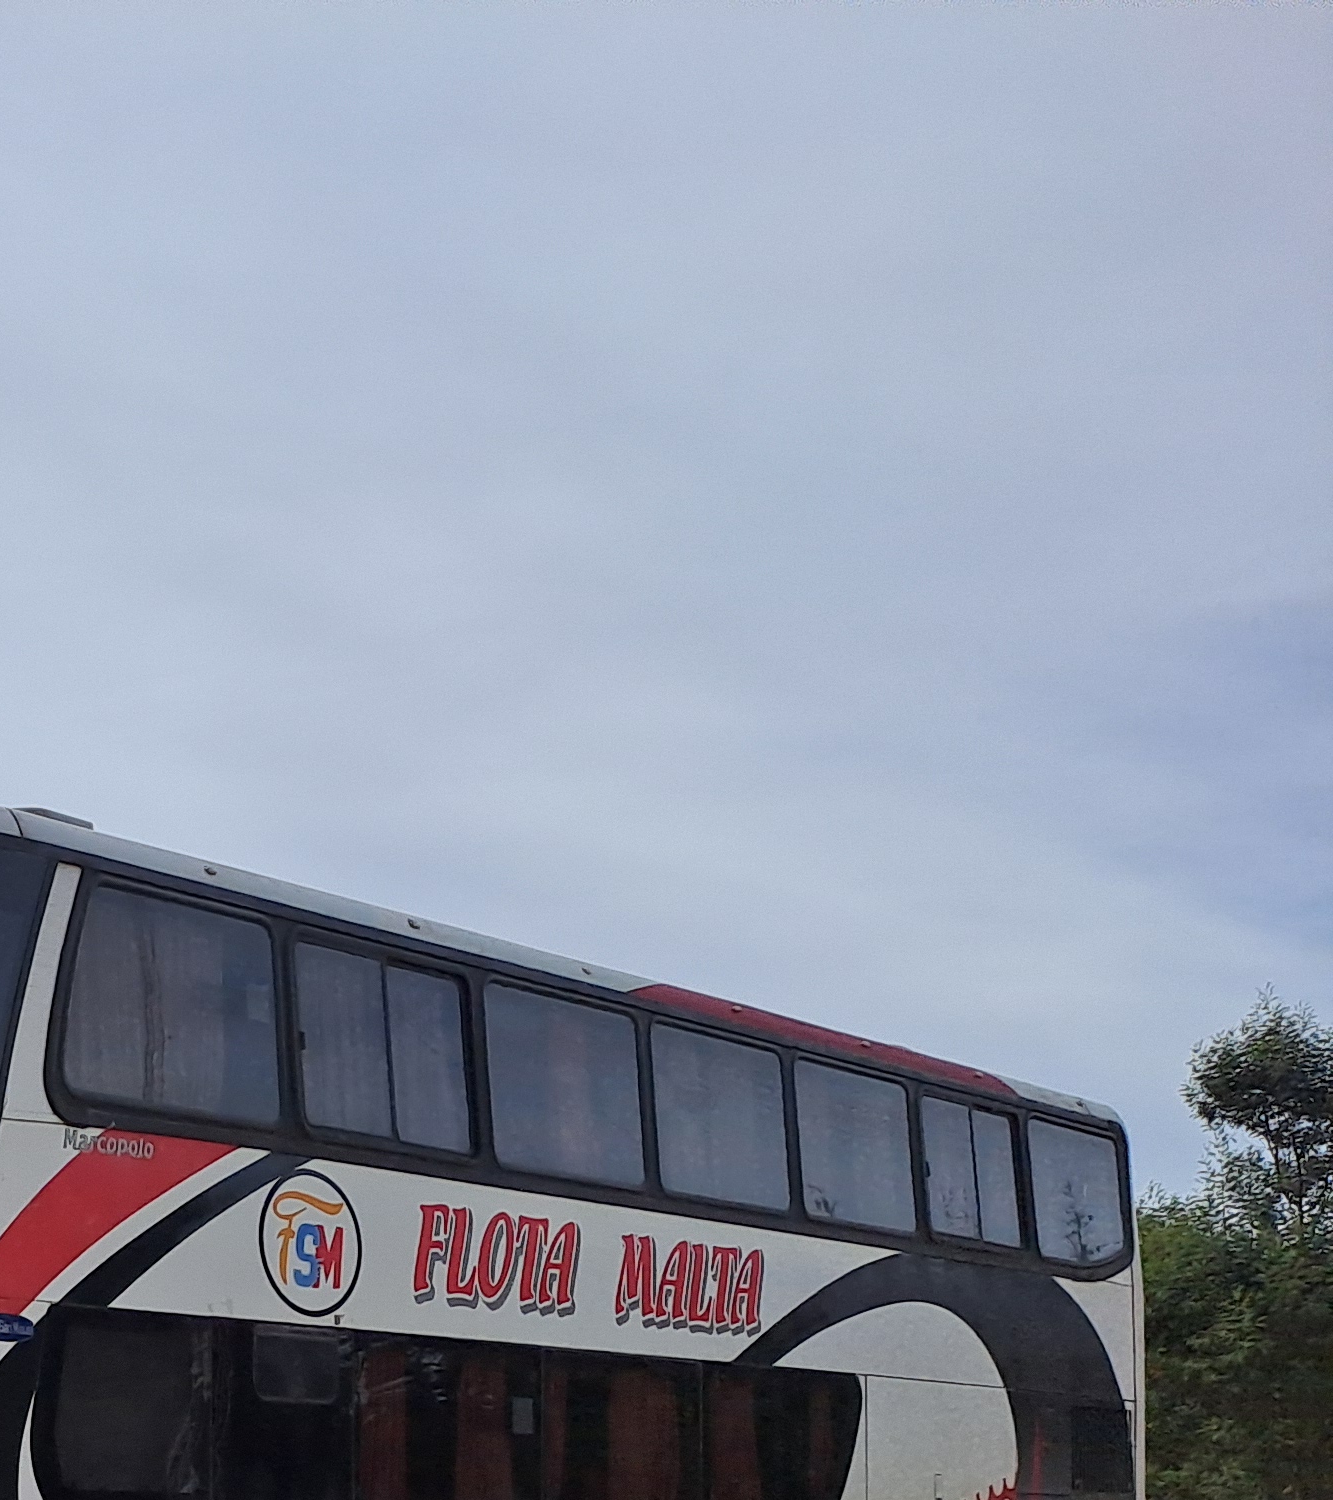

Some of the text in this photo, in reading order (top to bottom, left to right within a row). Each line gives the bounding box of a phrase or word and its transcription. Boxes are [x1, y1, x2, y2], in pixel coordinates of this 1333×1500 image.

[62, 1127, 155, 1160] Marcopolo
[412, 1203, 765, 1338] FLOTA MALTA
